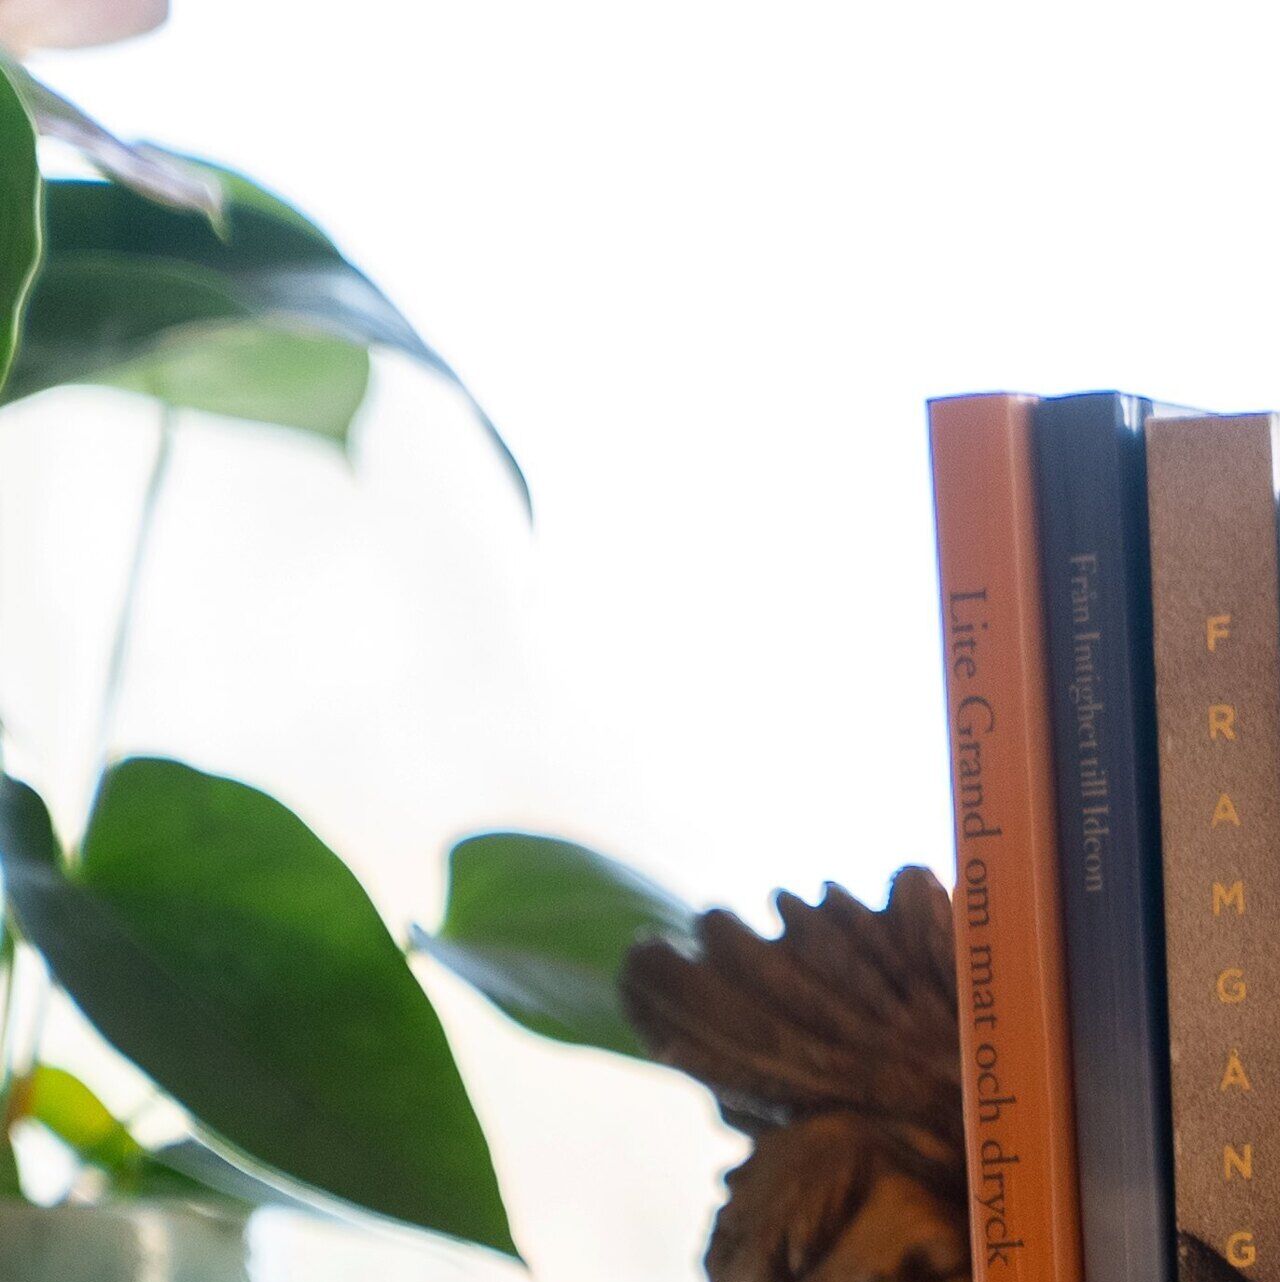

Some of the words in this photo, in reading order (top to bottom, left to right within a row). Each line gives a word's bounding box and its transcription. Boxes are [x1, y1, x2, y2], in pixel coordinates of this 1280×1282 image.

[949, 586, 988, 681] Lite
[953, 695, 1004, 842] Grand
[965, 857, 991, 930] om
[969, 944, 996, 1031] mat
[974, 1041, 1017, 1127] och
[981, 1140, 1025, 1269] dryck
